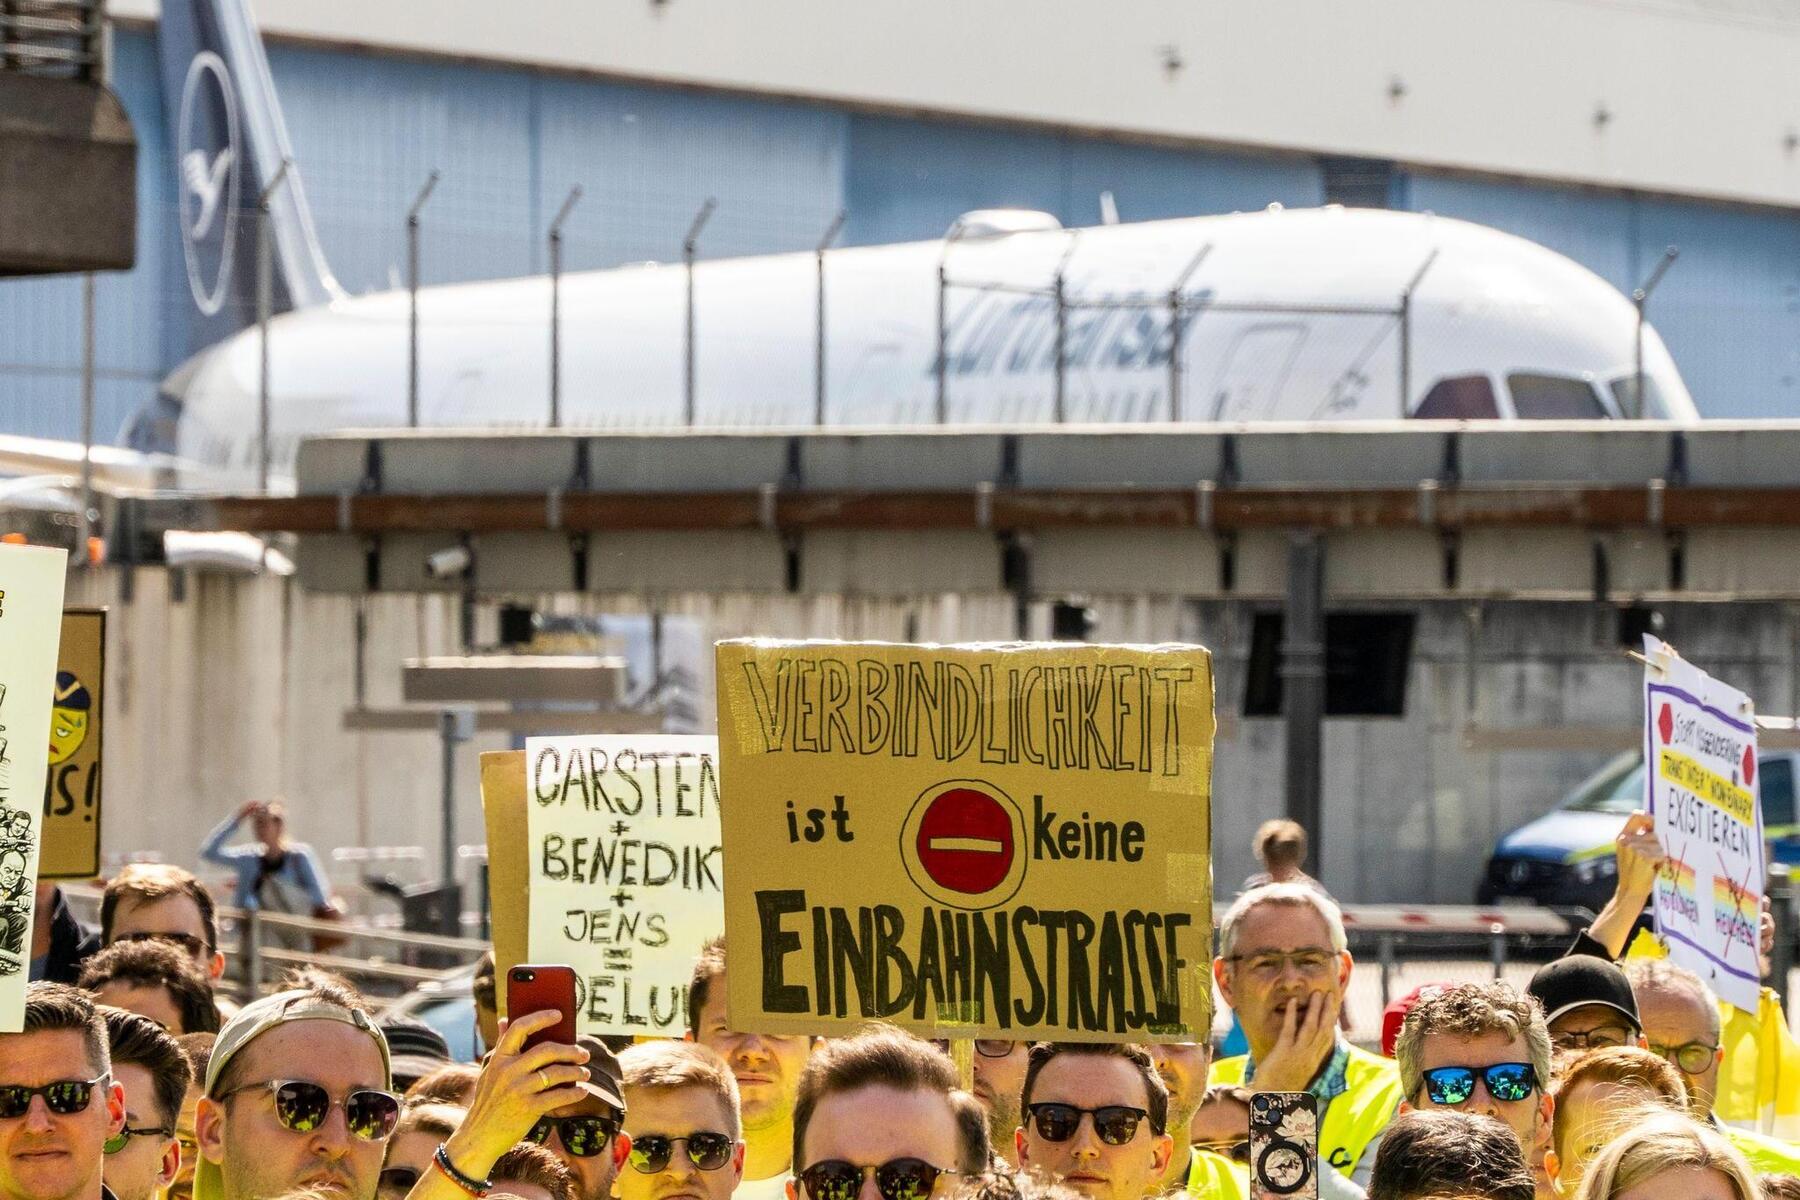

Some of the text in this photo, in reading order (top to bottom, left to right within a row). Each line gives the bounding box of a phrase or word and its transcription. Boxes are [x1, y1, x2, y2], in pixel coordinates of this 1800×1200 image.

[743, 658, 1194, 777] VERBINDLICHKEIT
[534, 745, 721, 818] CARSTEN
[786, 795, 1146, 862] ist keine
[1668, 787, 1751, 862] EXISTIEREN
[563, 909, 671, 948] JENS
[755, 890, 1192, 1035] EINBAHNSTRASSE
